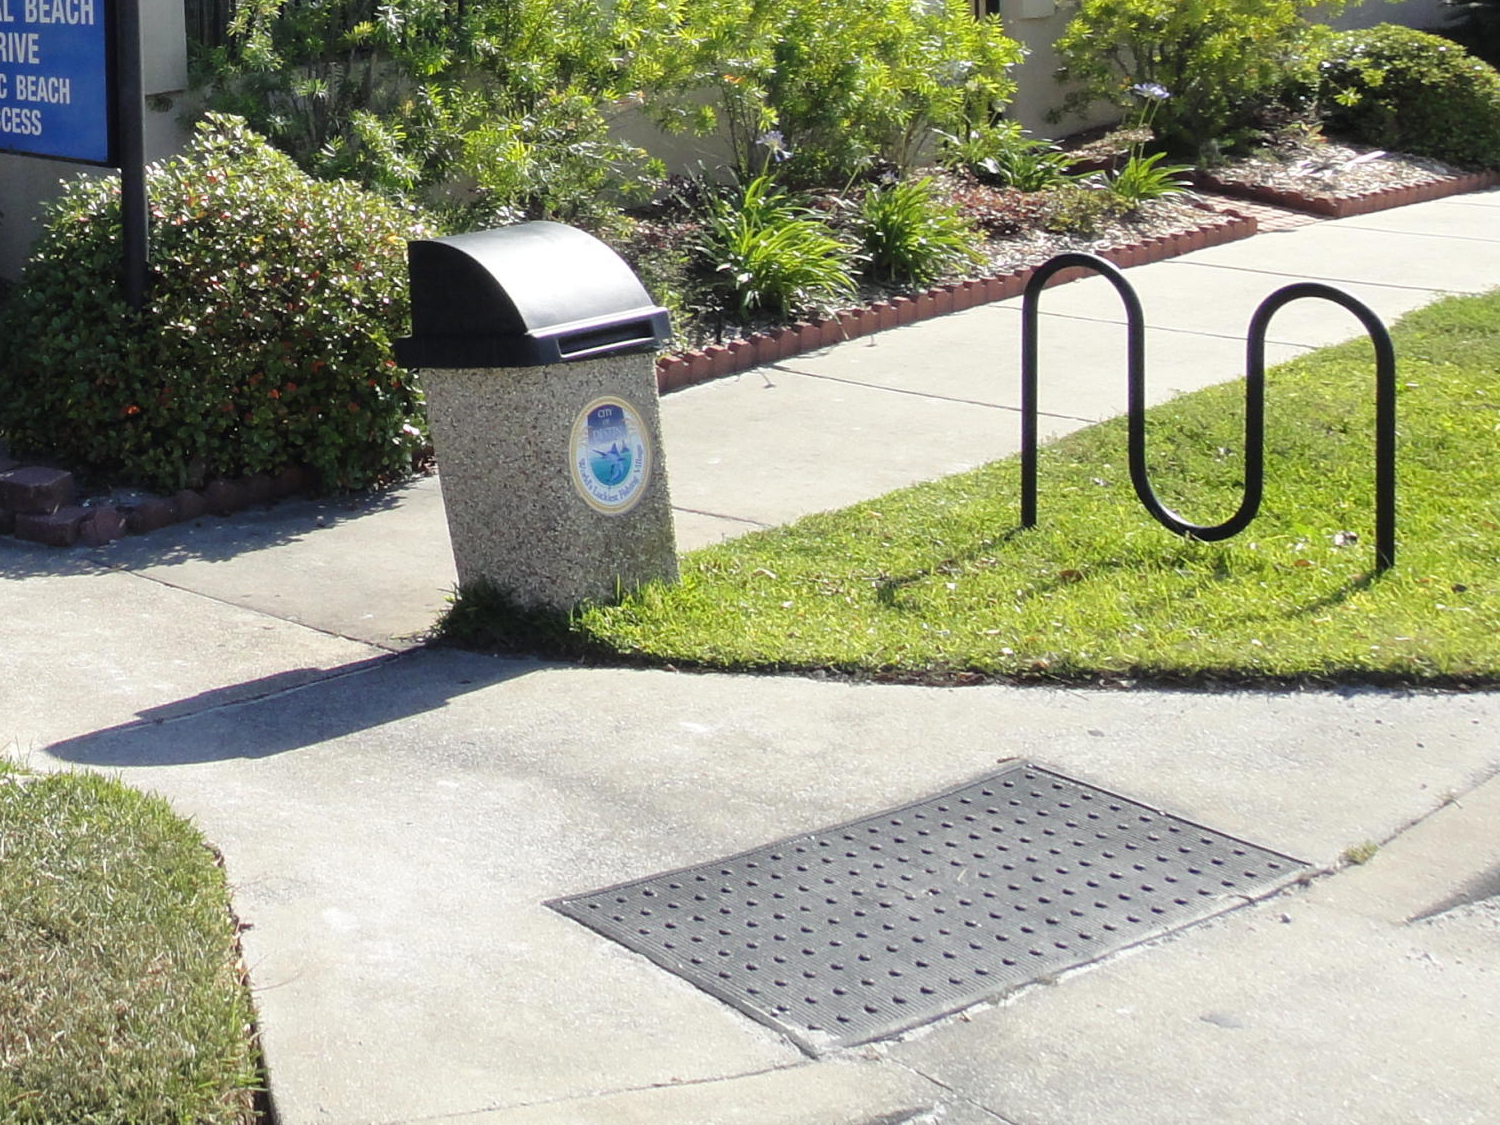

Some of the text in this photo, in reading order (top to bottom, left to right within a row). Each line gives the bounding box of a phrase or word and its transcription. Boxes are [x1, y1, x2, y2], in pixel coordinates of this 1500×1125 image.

[16, 74, 71, 105] BEACH
[597, 408, 612, 418] CITY
[592, 486, 619, 502] Luckiest
[618, 475, 640, 500] Fishing
